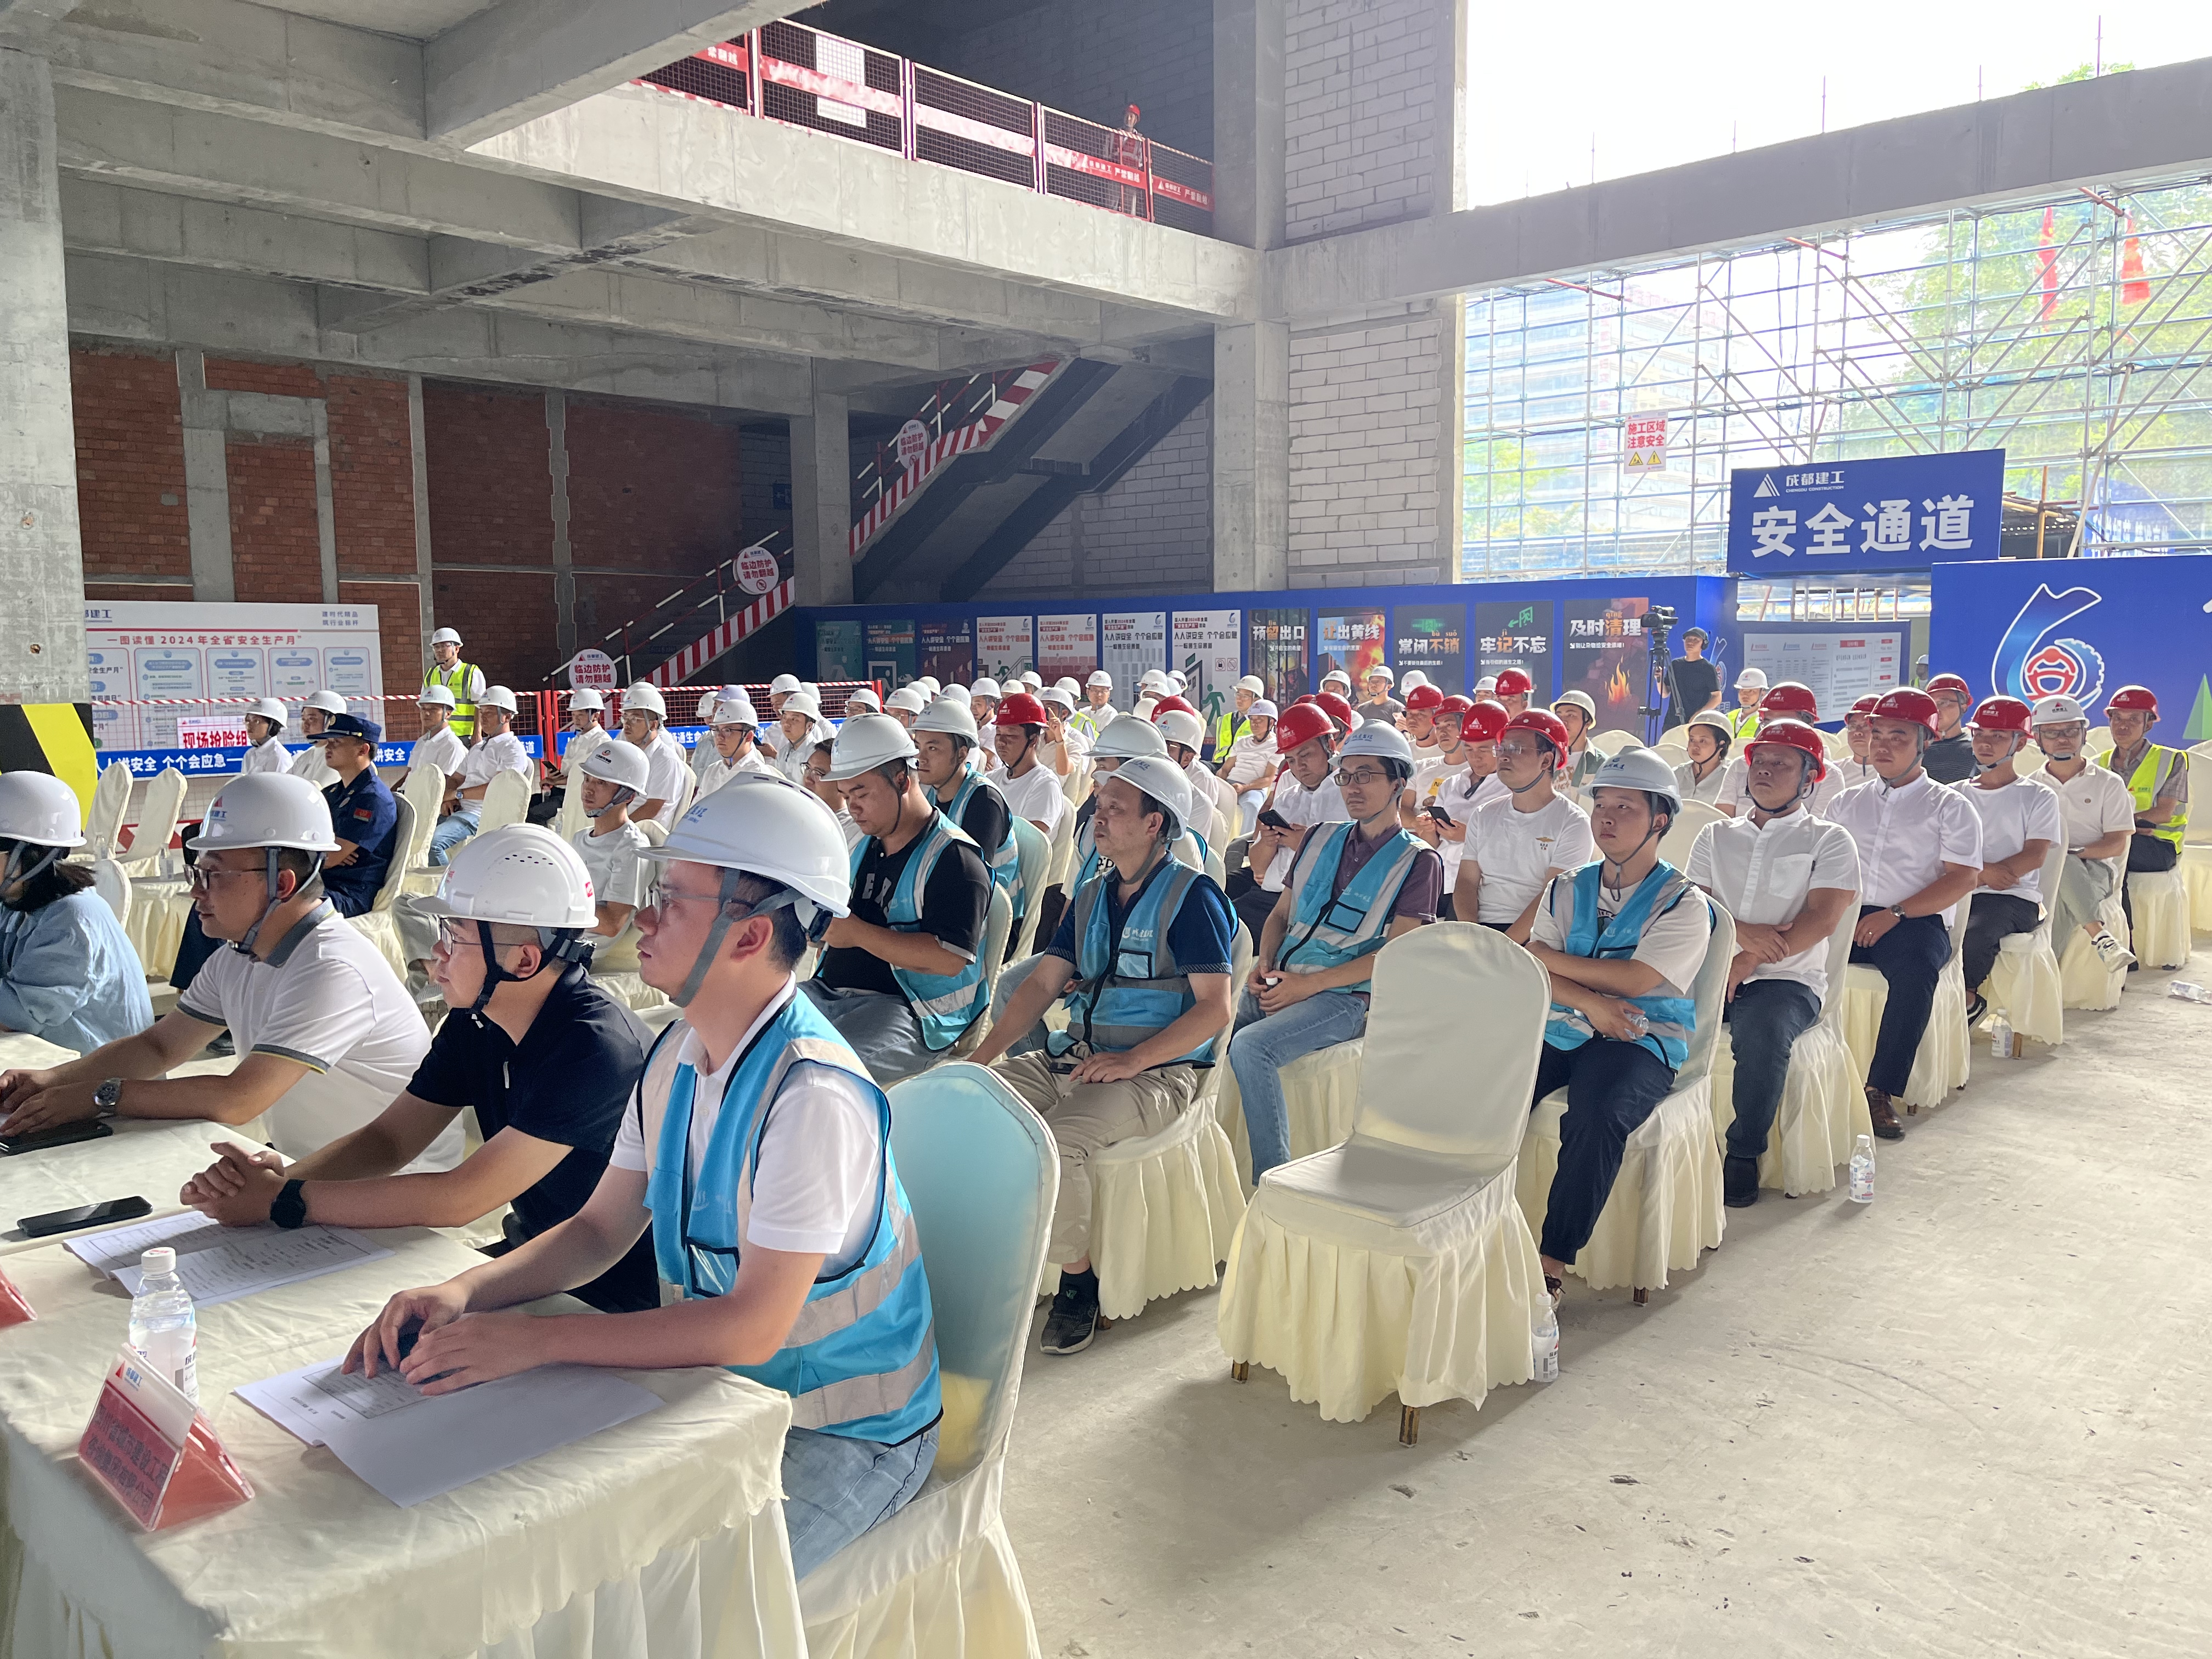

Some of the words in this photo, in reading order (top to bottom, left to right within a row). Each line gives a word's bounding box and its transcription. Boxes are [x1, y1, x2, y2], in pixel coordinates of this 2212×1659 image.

[1628, 420, 1666, 435] 施工区域
[1627, 434, 1664, 449] 注意安全
[1786, 471, 1845, 487] 成都建工
[1751, 494, 1974, 558] 安全通道
[1252, 625, 1305, 641] 预留出口
[1323, 624, 1380, 641] 让出黄线
[1570, 618, 1641, 637] 及时清理
[107, 635, 155, 645] 一图读懂
[1398, 637, 1460, 654] 常闭不锁
[1480, 636, 1547, 654] 牢记不忘
[574, 664, 610, 674] 临边防护
[575, 674, 612, 684] 请勿翻越
